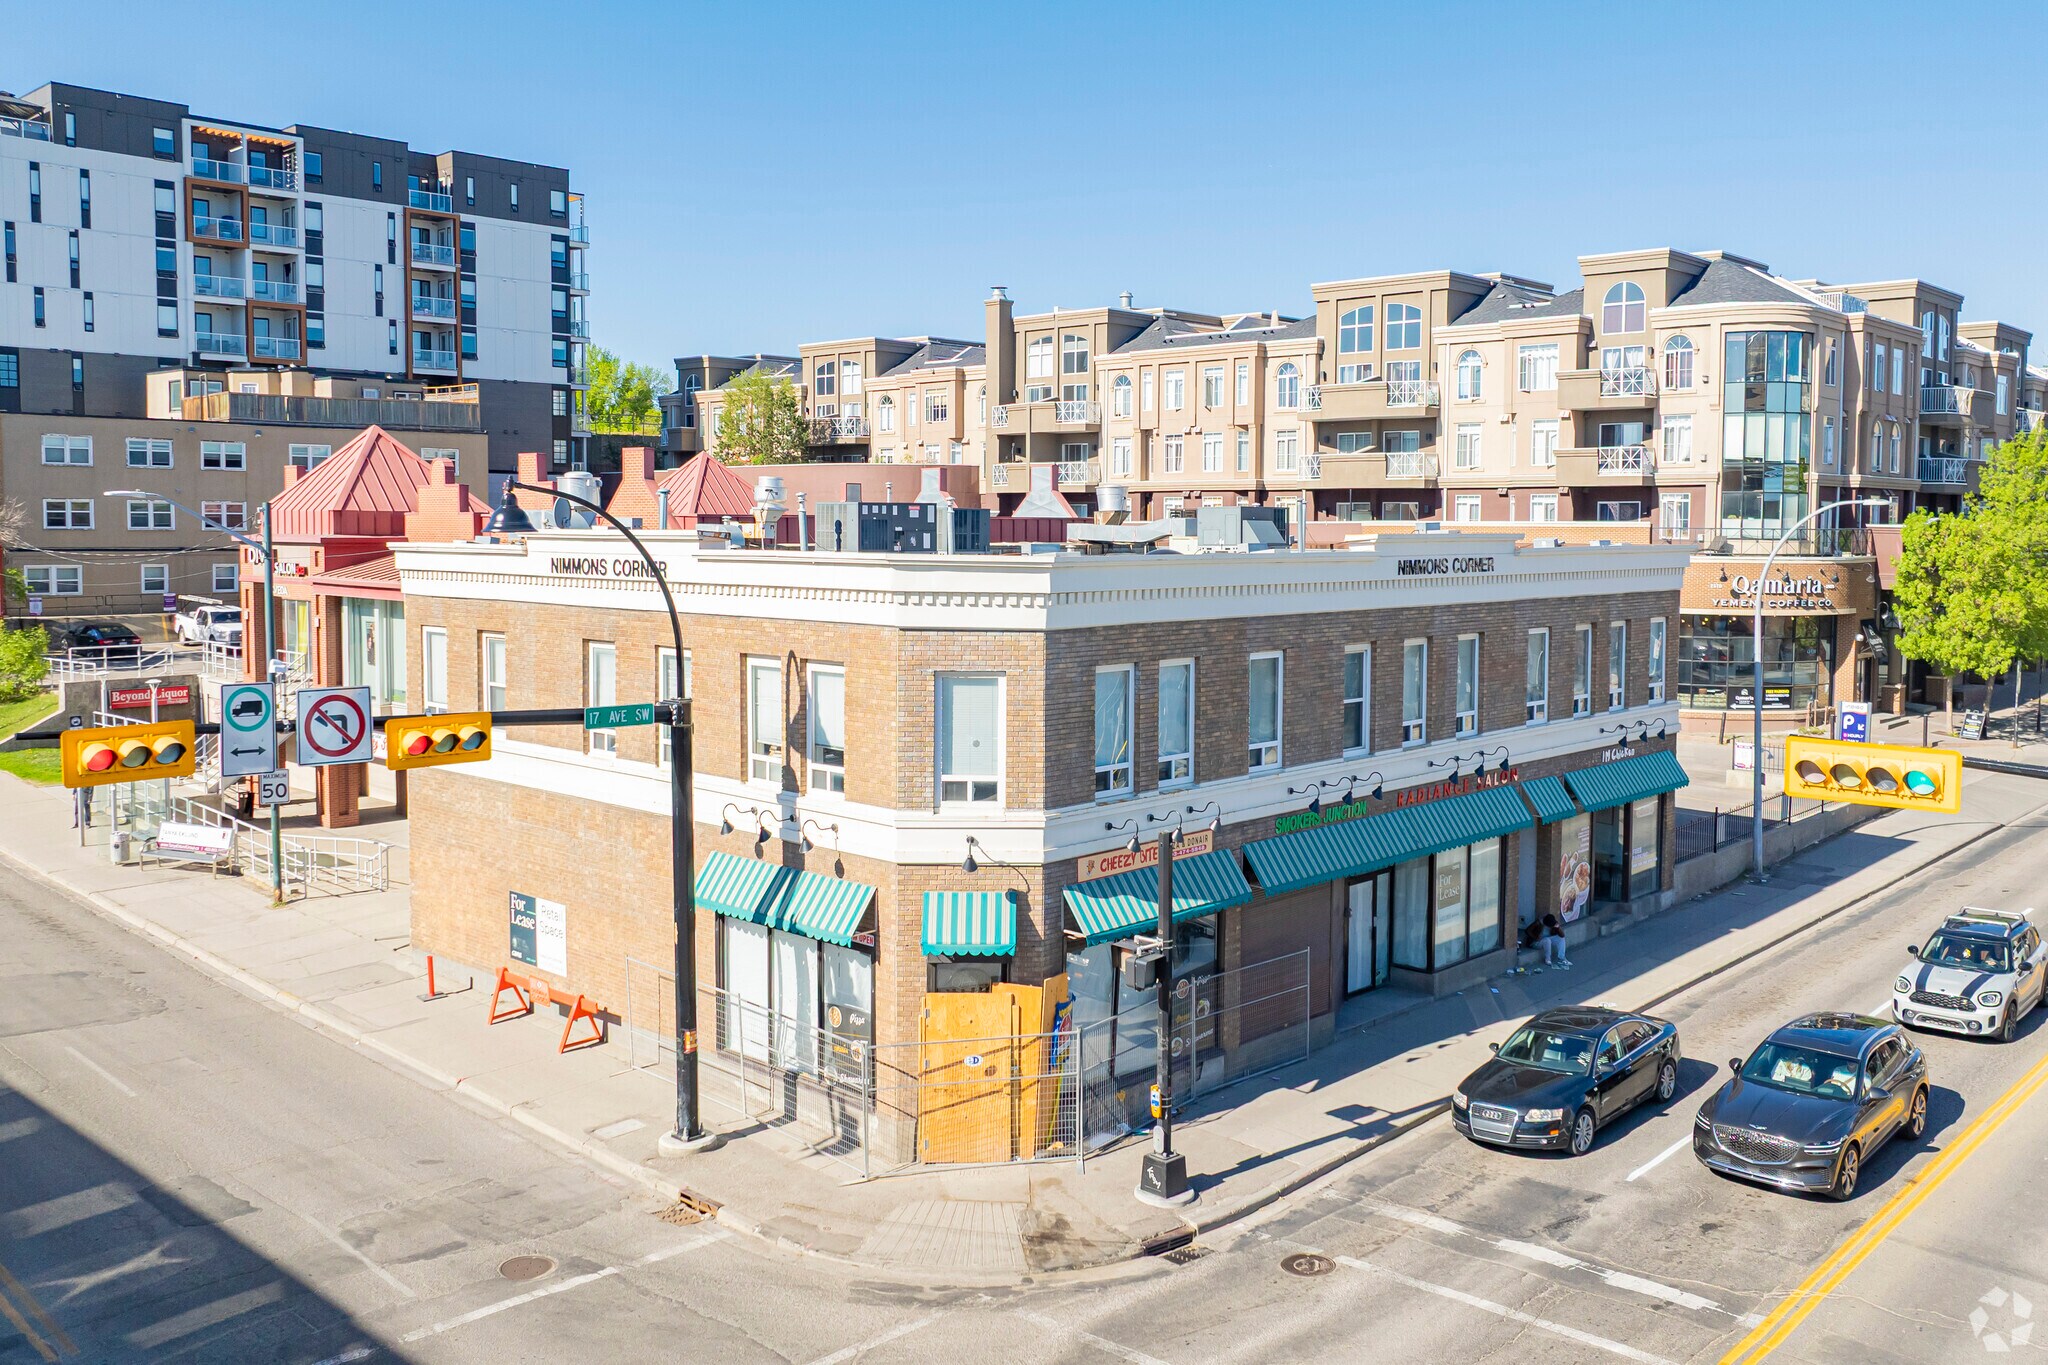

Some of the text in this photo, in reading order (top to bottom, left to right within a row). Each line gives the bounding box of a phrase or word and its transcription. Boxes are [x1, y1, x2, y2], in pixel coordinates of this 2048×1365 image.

[274, 562, 297, 575] SALON
[551, 557, 668, 579] NIMMONS CORNER
[1397, 557, 1495, 576] NIMMONS CORNER
[273, 586, 288, 596] VEDA
[1732, 575, 1822, 597] Qamaria
[1712, 599, 1758, 607] YEMEN
[1768, 599, 1814, 607] COFFEE
[112, 691, 151, 703] Beyond
[589, 708, 650, 725] 17 AVE SW
[1843, 714, 1855, 730] P
[262, 783, 287, 799] 50
[1397, 768, 1519, 807] RADIANCE SALON
[1275, 801, 1367, 834] SMOKERS JUNCTION
[1187, 834, 1209, 849] DONAIR
[1100, 846, 1159, 872] CHEEZY BITE
[1440, 873, 1452, 887] For
[1440, 885, 1461, 901] Lease
[511, 894, 526, 912] For
[511, 909, 535, 930] Lease
[859, 934, 874, 945] OPEN
[849, 1013, 866, 1026] Pizza
